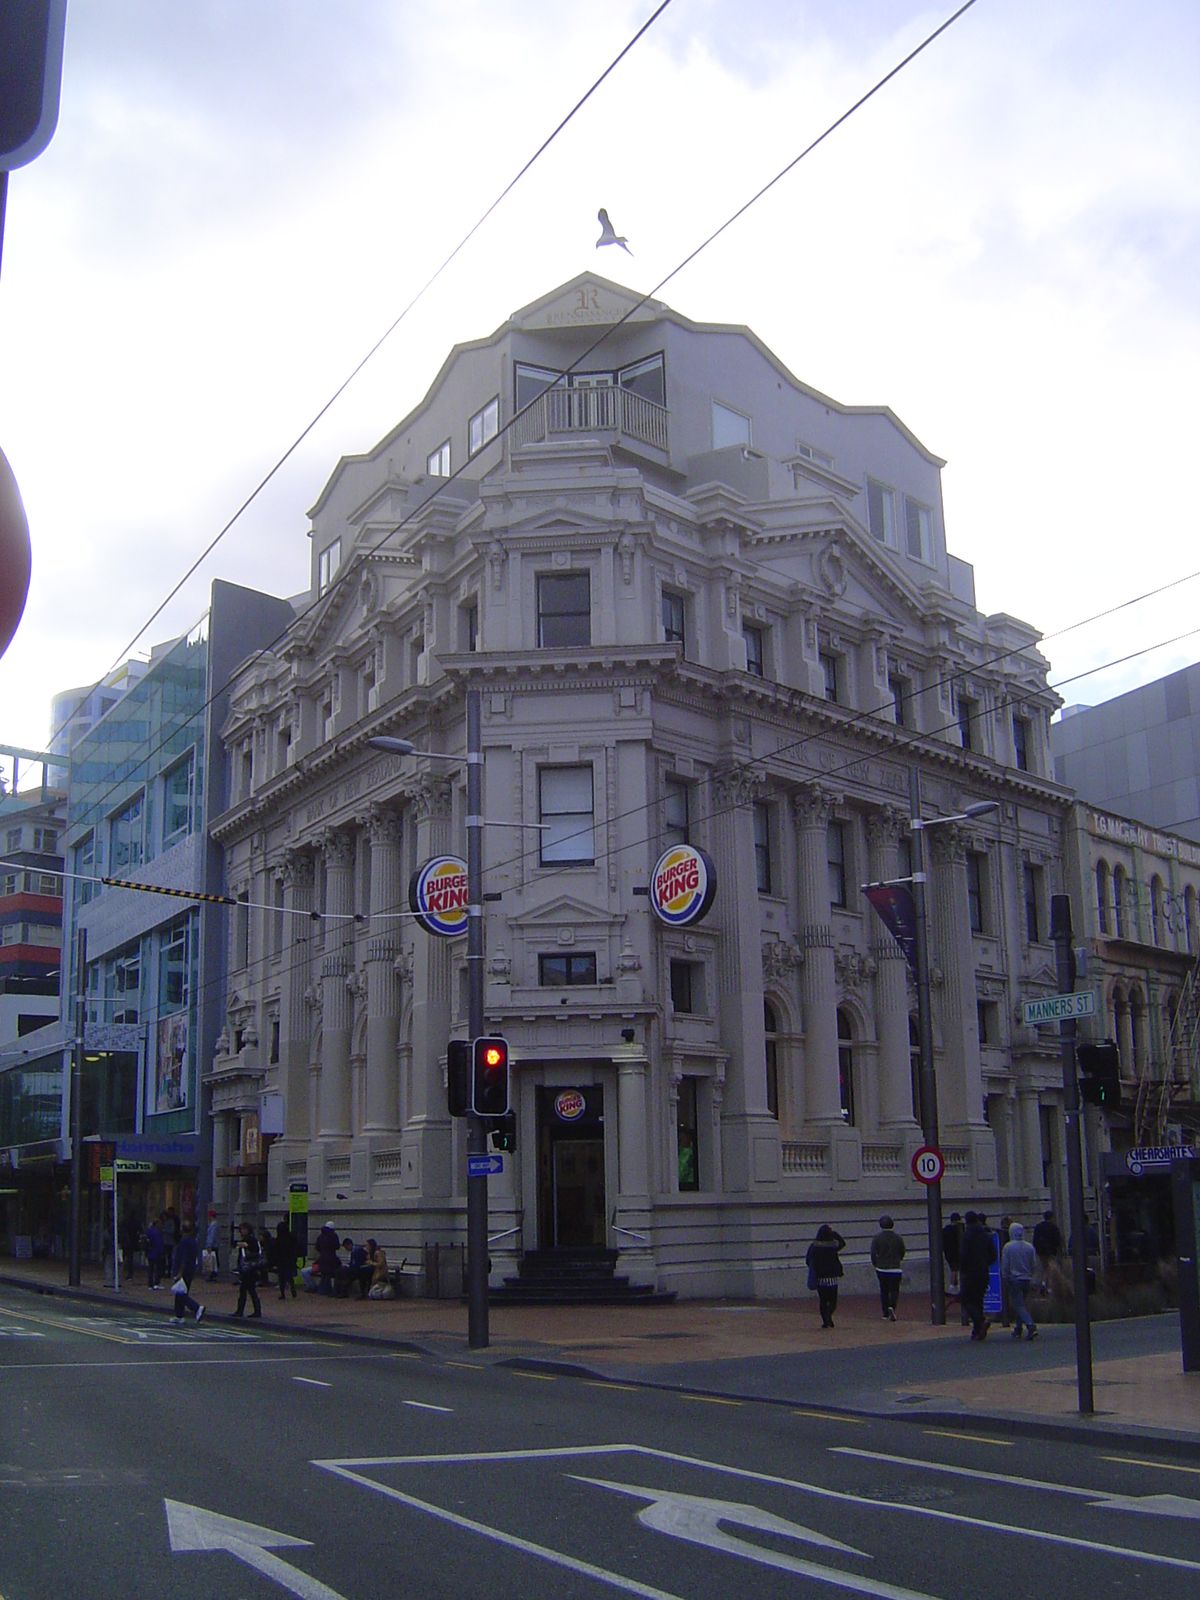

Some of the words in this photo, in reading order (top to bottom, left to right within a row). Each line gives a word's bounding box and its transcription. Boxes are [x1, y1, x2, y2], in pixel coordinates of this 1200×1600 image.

[657, 858, 697, 889] BURGER
[427, 875, 467, 895] BURGE
[659, 870, 699, 907] KING
[1028, 998, 1073, 1020] MANNERS
[1076, 996, 1088, 1013] ST
[560, 1100, 582, 1113] KING
[922, 1158, 936, 1173] 10
